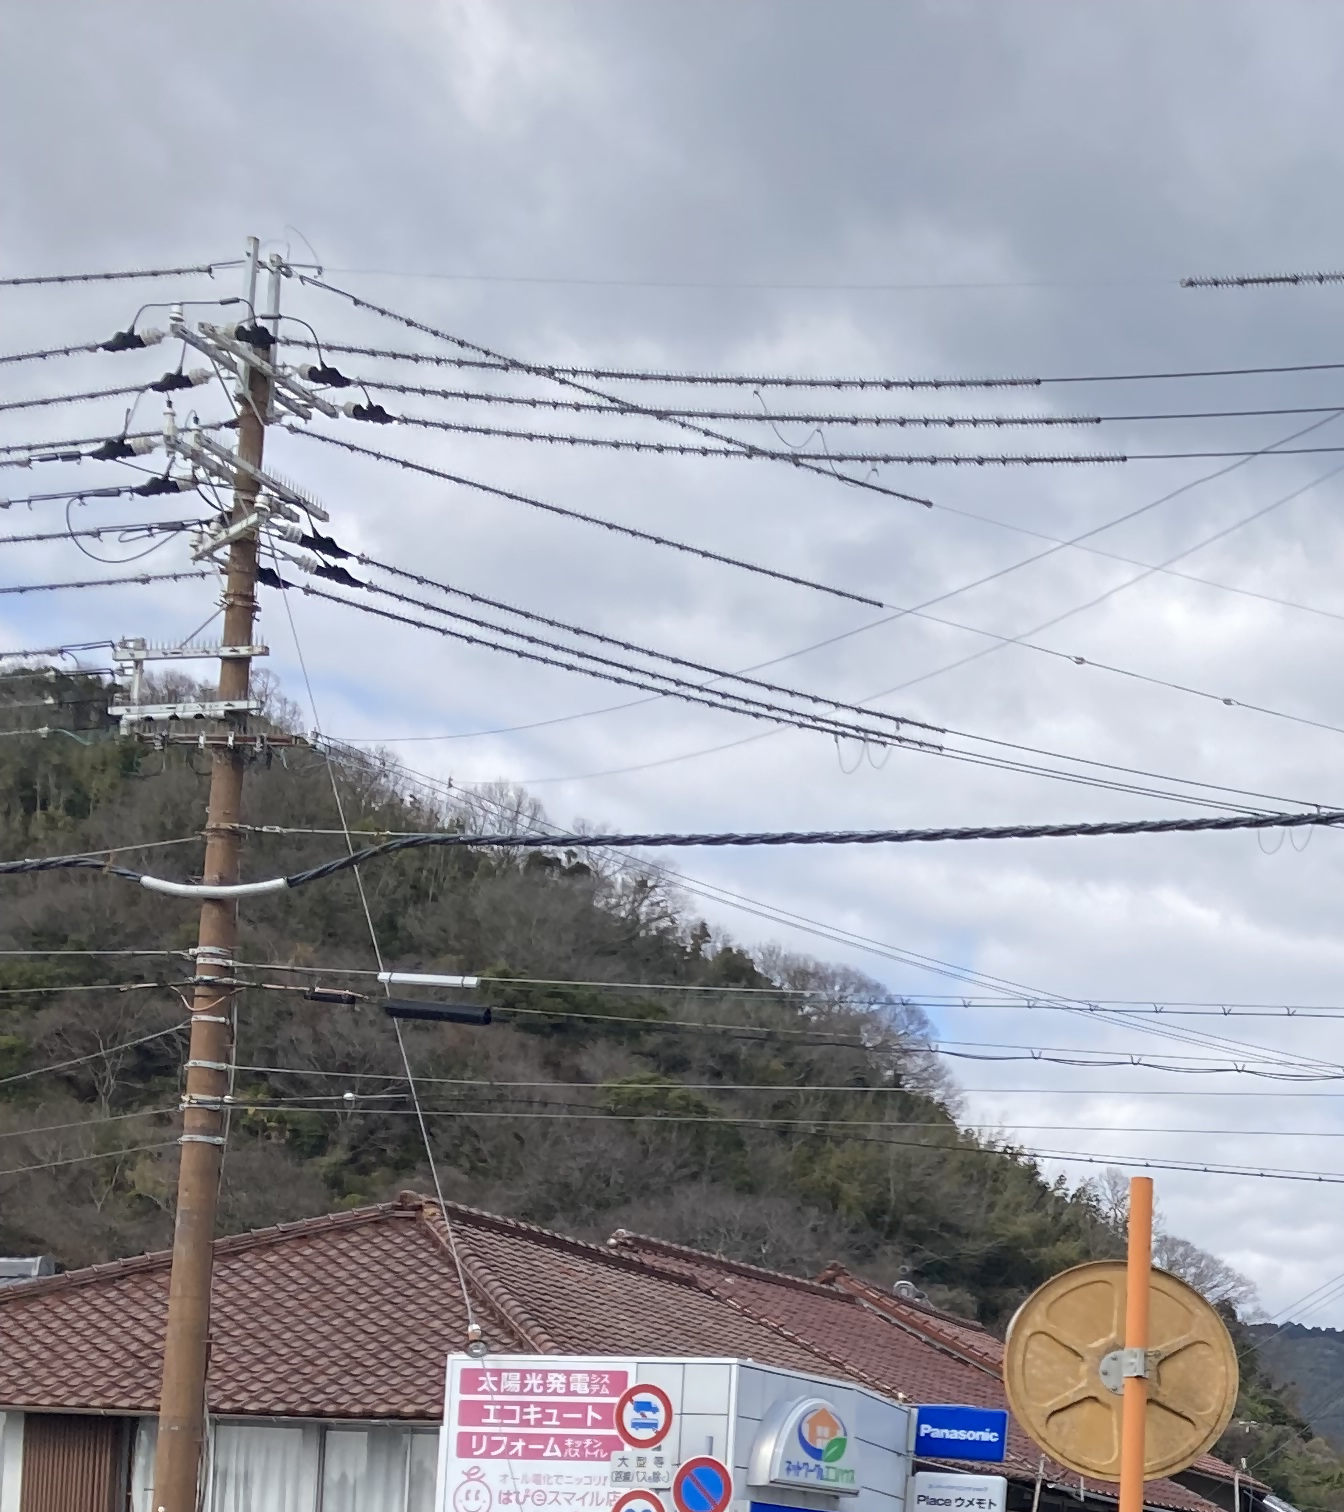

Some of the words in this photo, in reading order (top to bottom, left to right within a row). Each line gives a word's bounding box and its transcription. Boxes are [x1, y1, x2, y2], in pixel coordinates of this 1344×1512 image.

[477, 1372, 590, 1394] 太陽光発電
[481, 1404, 602, 1427] エコキュート
[919, 1424, 1000, 1443] Panasonic
[471, 1435, 561, 1457] リフォーム
[916, 1494, 953, 1508] Place
[954, 1497, 997, 1511] ウメモト
